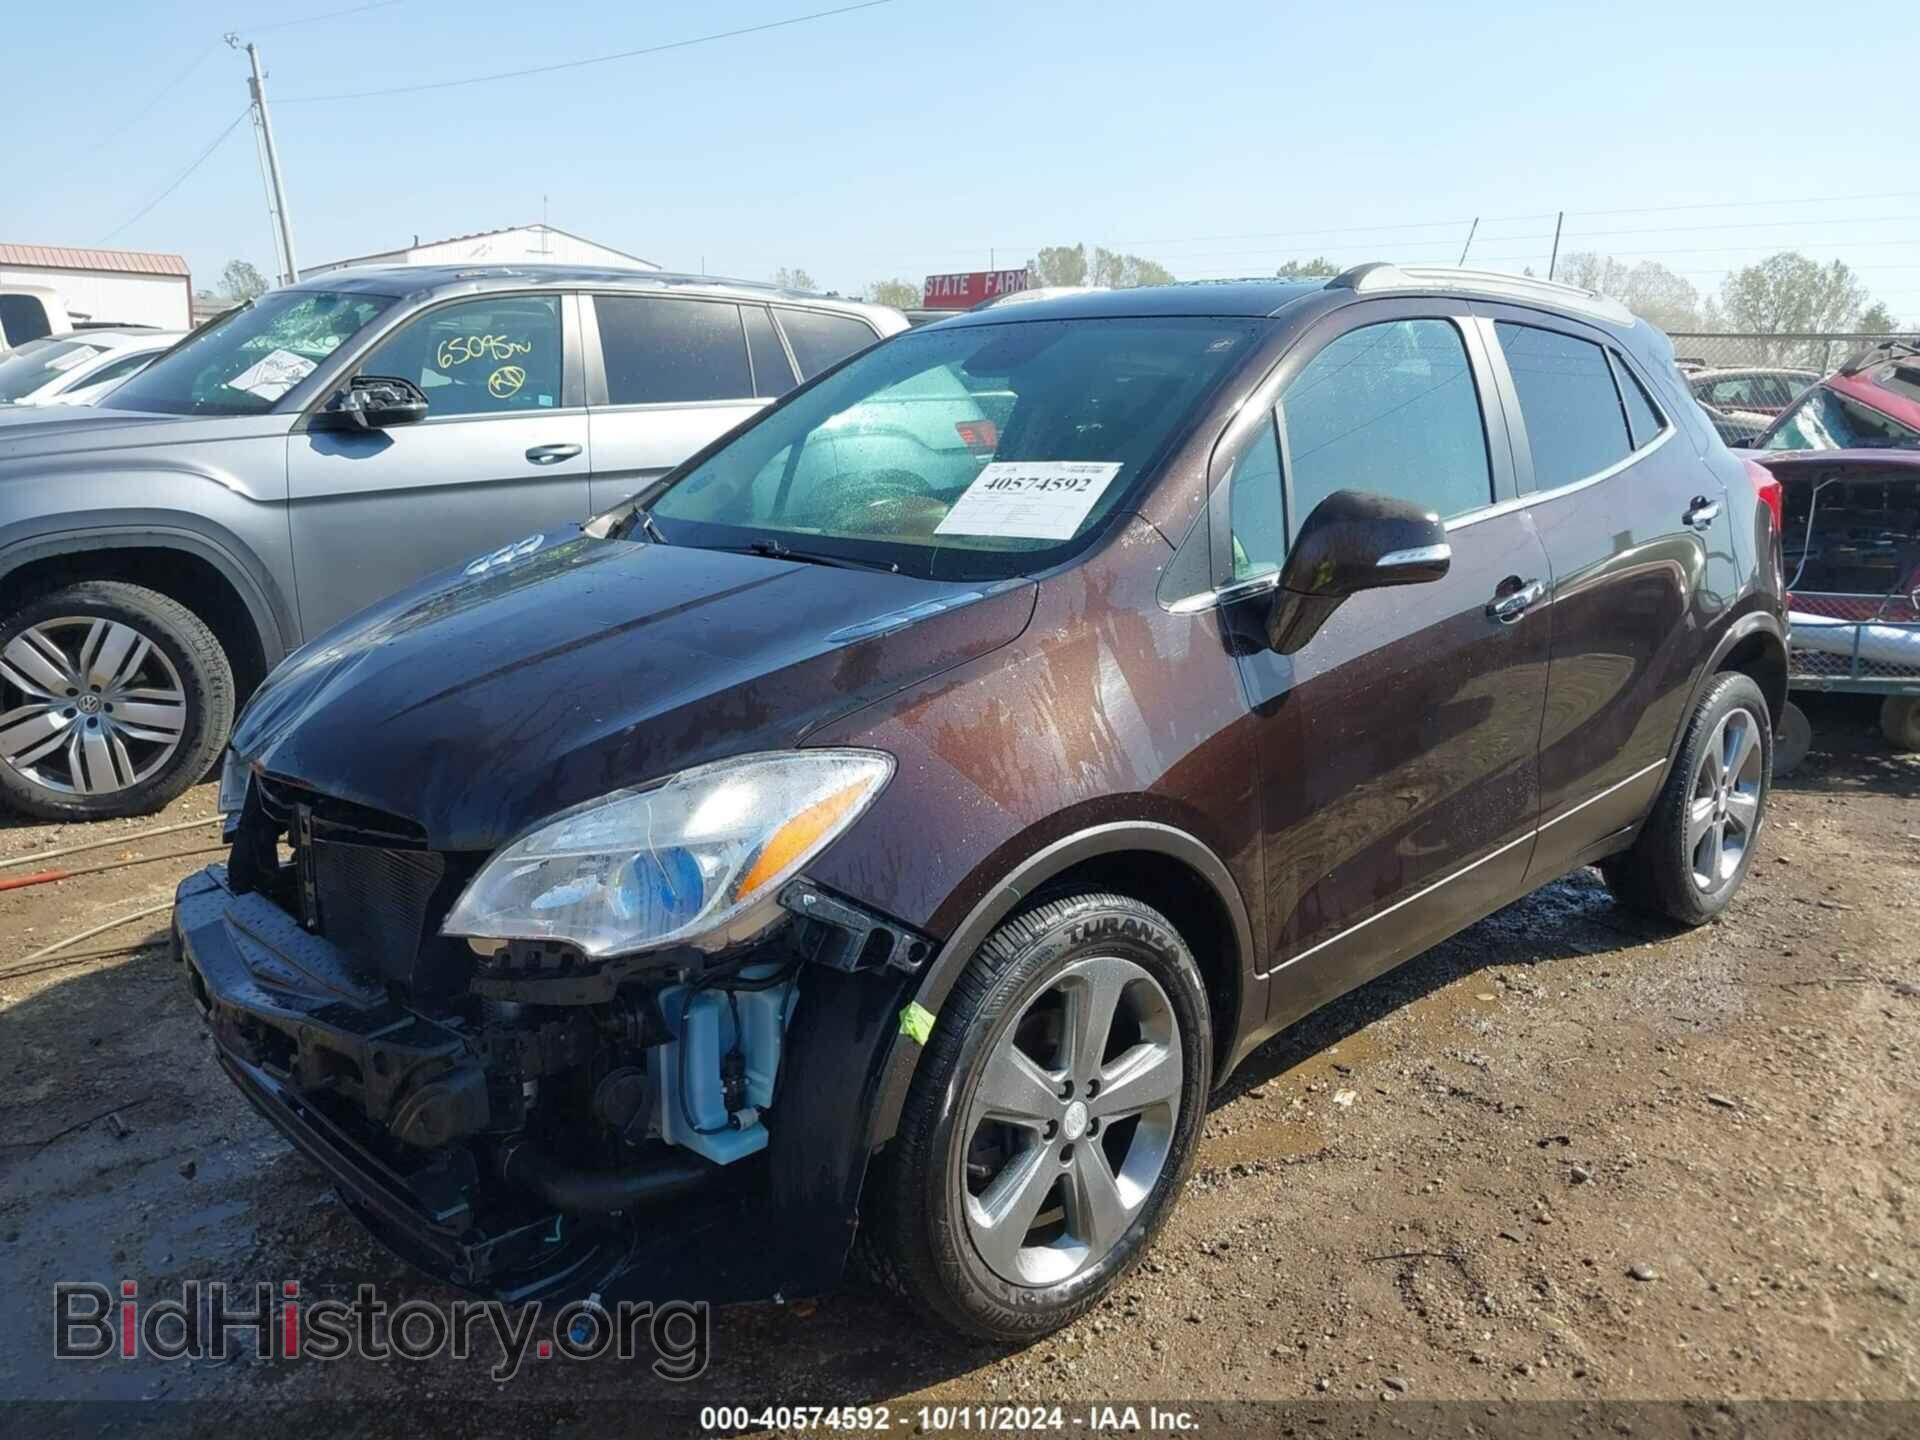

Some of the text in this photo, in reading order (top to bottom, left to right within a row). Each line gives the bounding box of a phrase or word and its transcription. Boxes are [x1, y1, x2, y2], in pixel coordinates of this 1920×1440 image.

[926, 270, 1026, 297] STATE FARM
[984, 477, 1092, 492] 40574592
